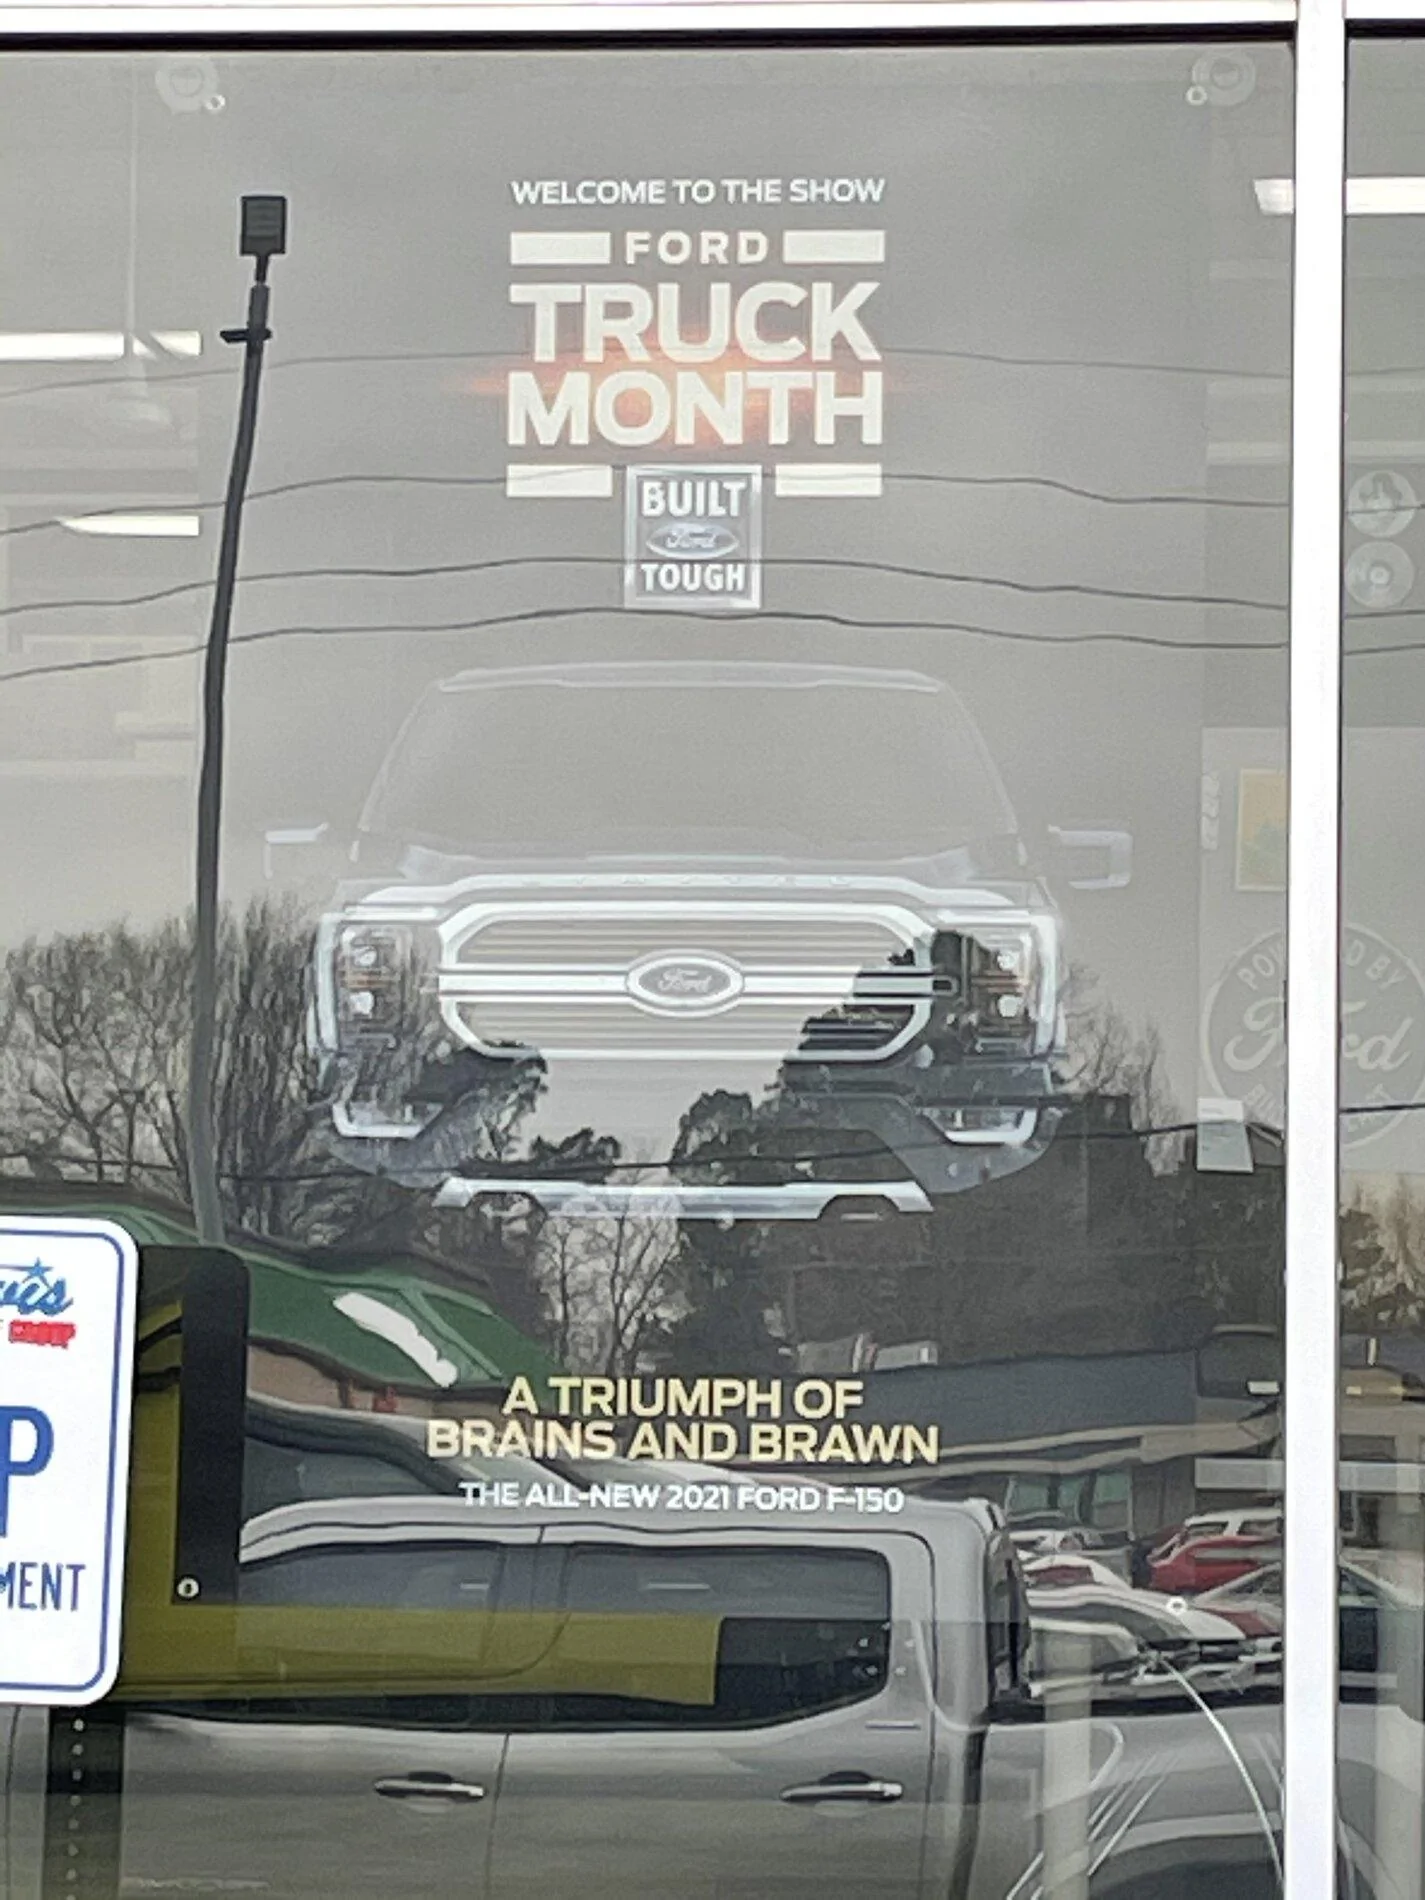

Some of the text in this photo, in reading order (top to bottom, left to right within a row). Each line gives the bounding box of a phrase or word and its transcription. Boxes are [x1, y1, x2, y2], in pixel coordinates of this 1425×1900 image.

[511, 178, 885, 204] WELCOME TO THE SHOW
[625, 230, 769, 265] FORD
[509, 281, 882, 364] TRUCK
[507, 370, 884, 446] MONTH
[642, 480, 747, 517] BUILT
[640, 563, 746, 592] TOUGH
[657, 967, 713, 993] Ford
[1365, 955, 1407, 990] BY
[502, 1376, 864, 1420] A TRIUMPH OF
[427, 1418, 939, 1465] BRAINS AND BRAWN
[457, 1481, 906, 1514] THE ALL-NEW 2021 FORD F-150
